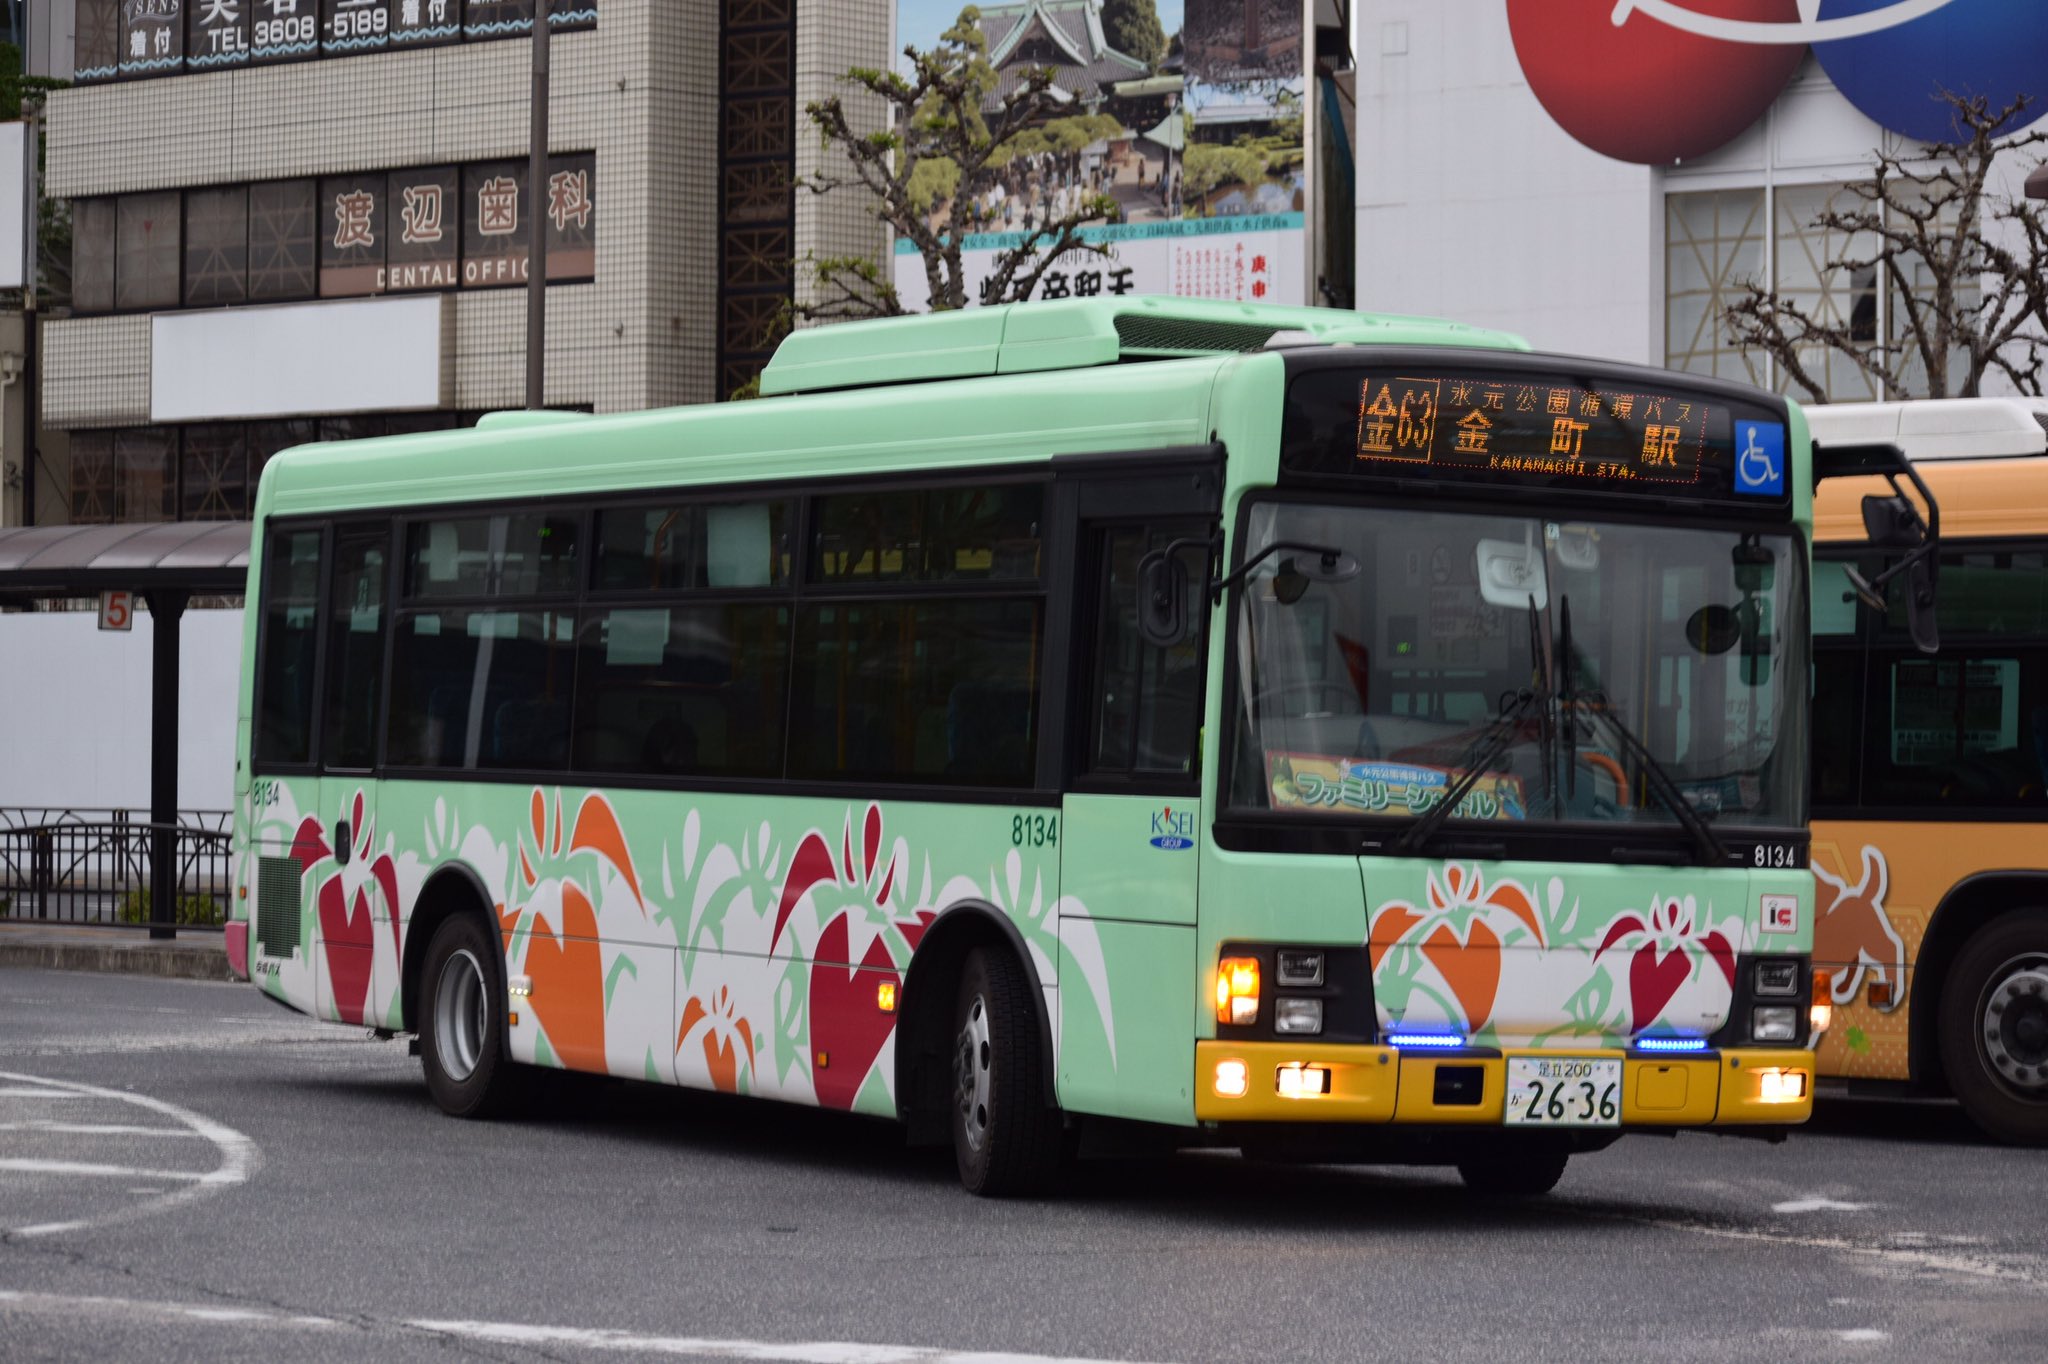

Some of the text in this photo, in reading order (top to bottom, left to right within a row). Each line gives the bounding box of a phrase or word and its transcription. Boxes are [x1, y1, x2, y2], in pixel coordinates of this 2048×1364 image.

[207, 26, 249, 53] TEL
[334, 168, 592, 248] 渡辺歯科
[376, 257, 530, 289] DENTAL OFFIC
[1454, 408, 1681, 469] 金町駅
[107, 592, 128, 627] 5
[253, 781, 279, 807] 8134
[1296, 771, 1499, 820] ファミリーシル
[1012, 814, 1057, 848] 8134
[1754, 844, 1795, 868] 8134
[1525, 1081, 1617, 1120] 26-36
